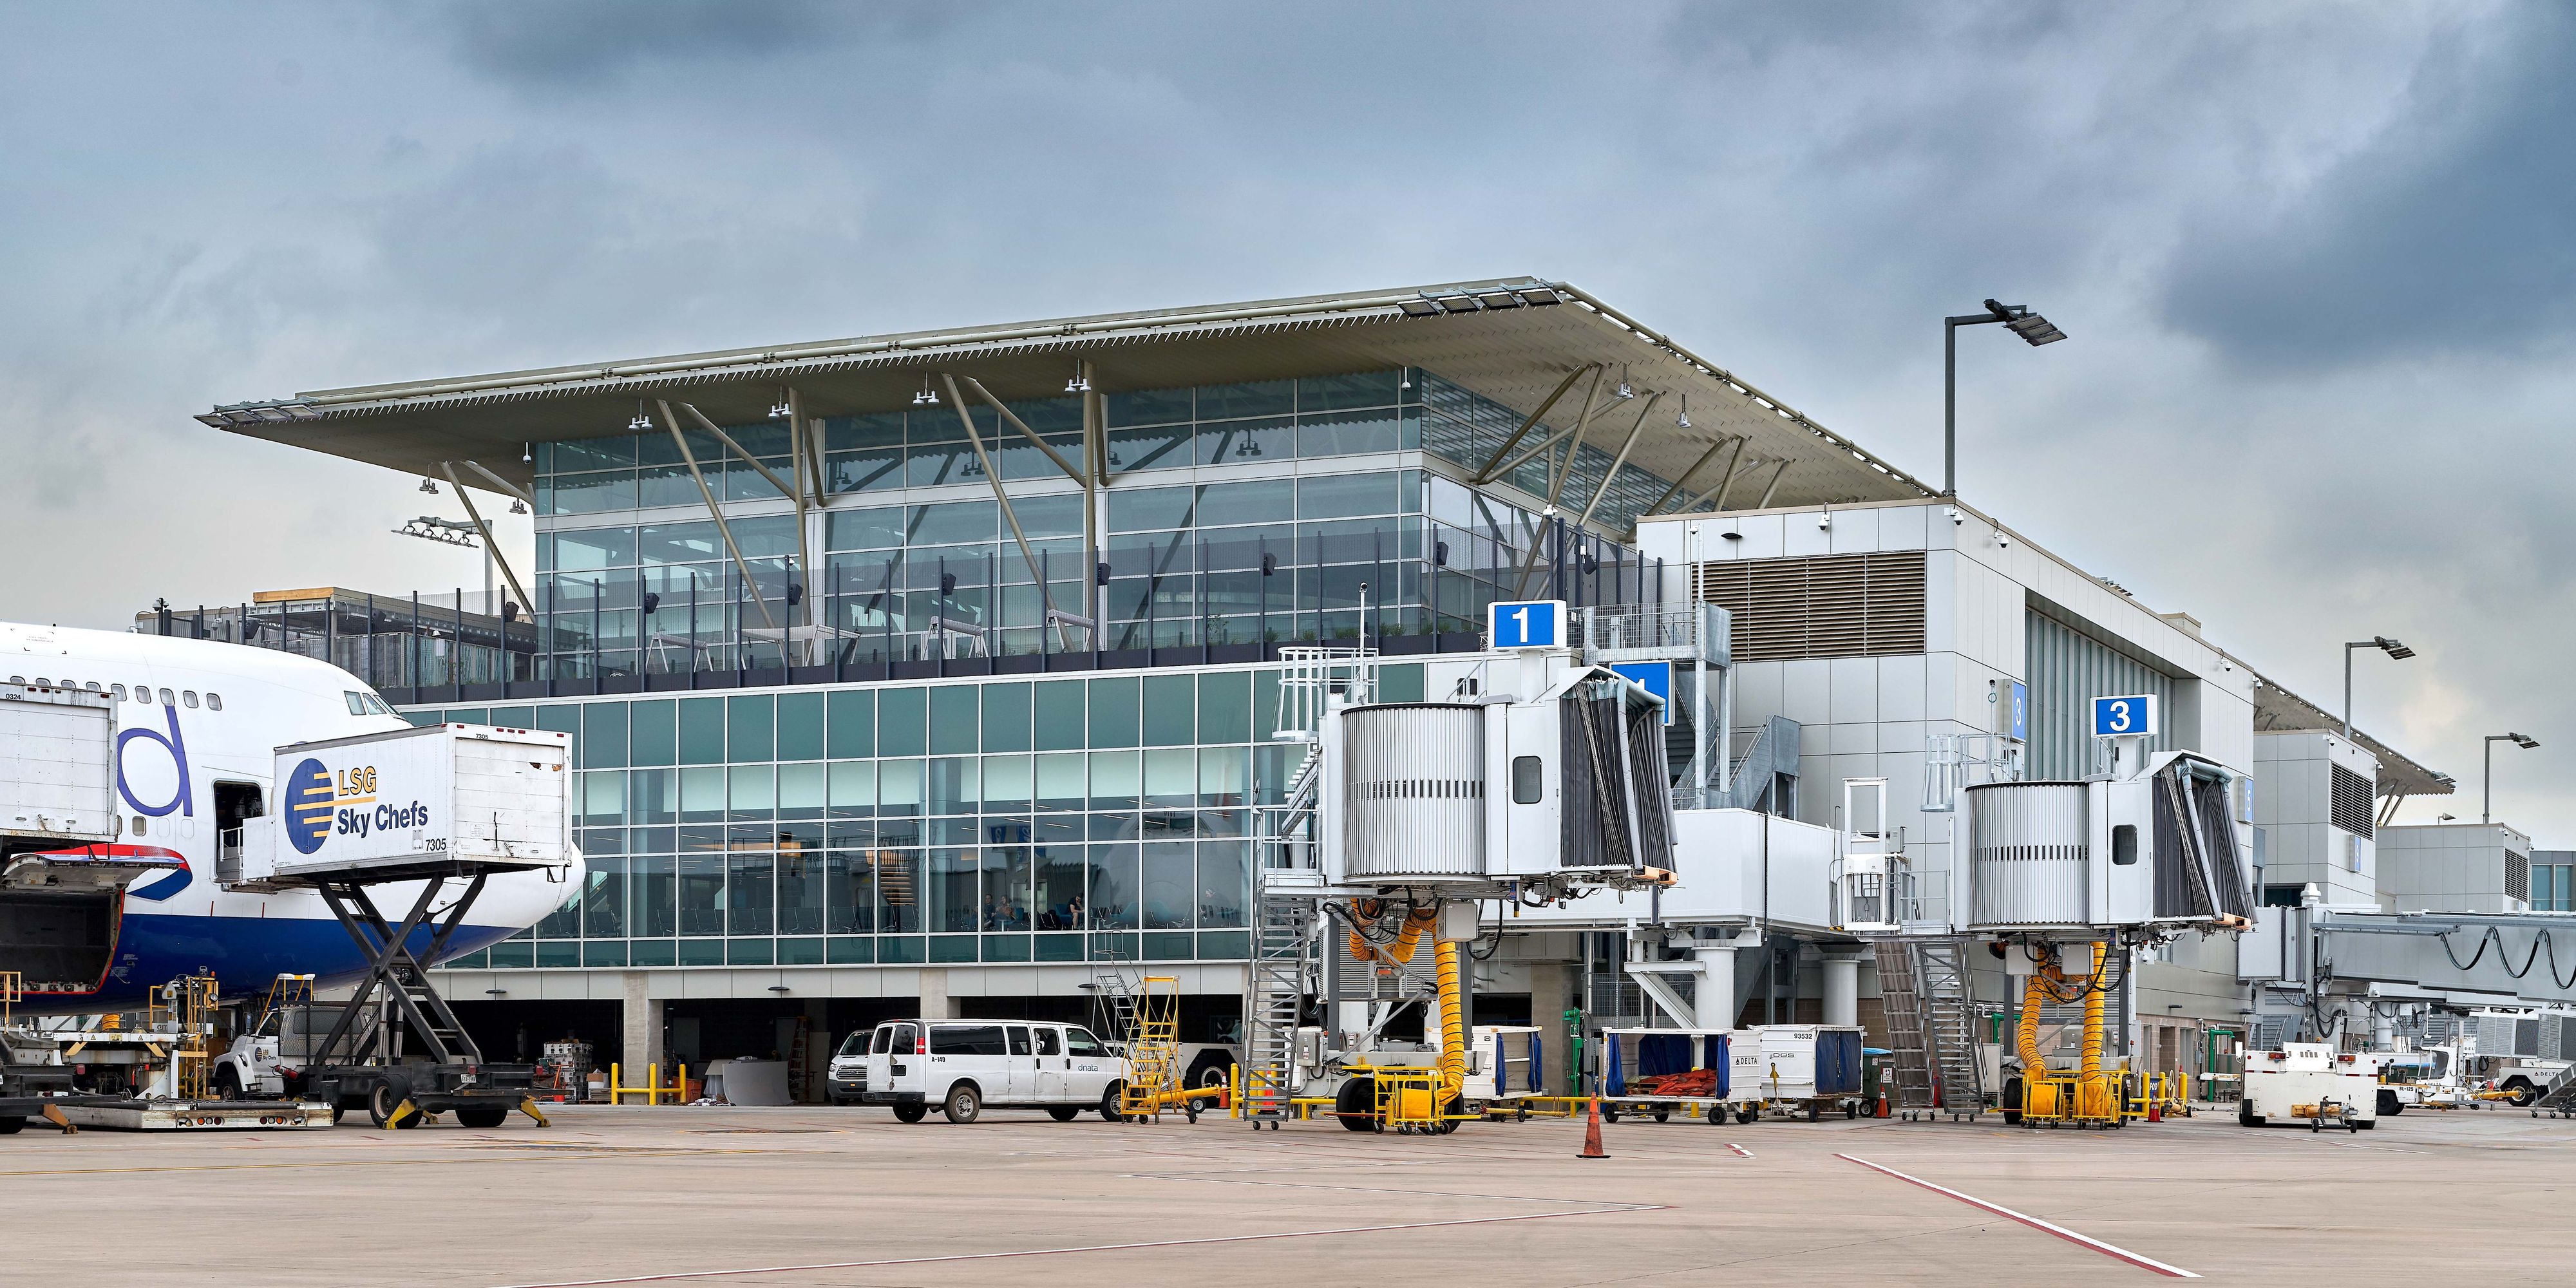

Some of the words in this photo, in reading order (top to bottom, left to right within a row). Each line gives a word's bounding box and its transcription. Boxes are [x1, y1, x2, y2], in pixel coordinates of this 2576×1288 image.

[1512, 607, 1528, 643] 1
[2016, 697, 2022, 726] 3
[2110, 701, 2131, 732] 3
[339, 766, 377, 797] LSG
[2247, 790, 2251, 811] 5
[338, 808, 370, 838] Sky
[375, 800, 428, 831] Chefs
[426, 838, 446, 851] 7305
